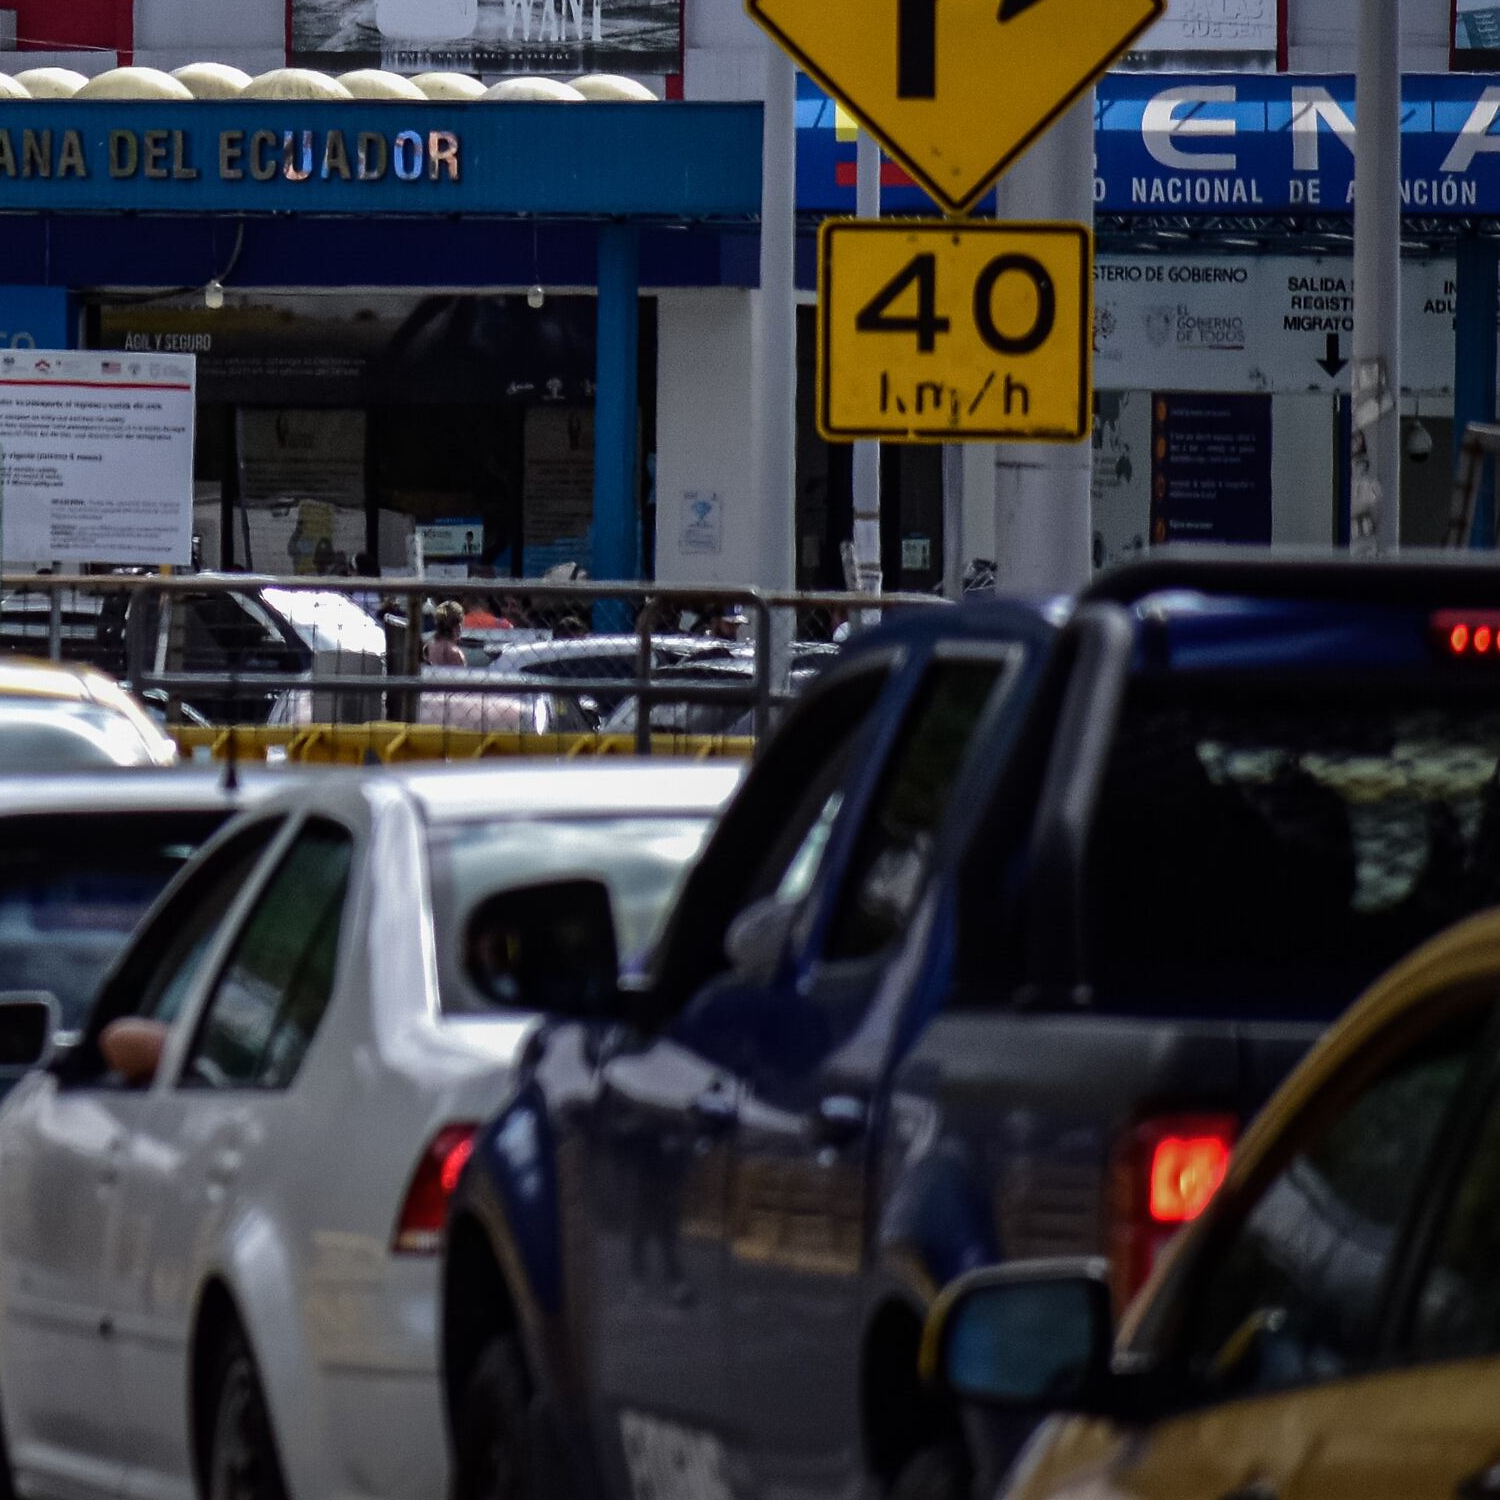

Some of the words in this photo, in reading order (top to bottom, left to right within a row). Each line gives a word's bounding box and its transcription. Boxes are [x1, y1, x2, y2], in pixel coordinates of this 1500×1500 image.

[108, 127, 198, 181] DEL
[217, 128, 462, 183] ECUADOR
[1131, 176, 1263, 204] NACIONAL
[1289, 179, 1320, 204] DE
[1094, 265, 1142, 283] STERIO
[1145, 266, 1164, 283] DE
[1167, 266, 1248, 284] GOBIERNO
[1288, 276, 1346, 293] SALIDA
[855, 251, 1057, 358] 40
[1291, 295, 1354, 311] REGIST
[1424, 299, 1457, 314] ADU
[1283, 315, 1354, 331] MIGRATO
[155, 333, 163, 350] Y
[164, 333, 212, 352] SEGURO
